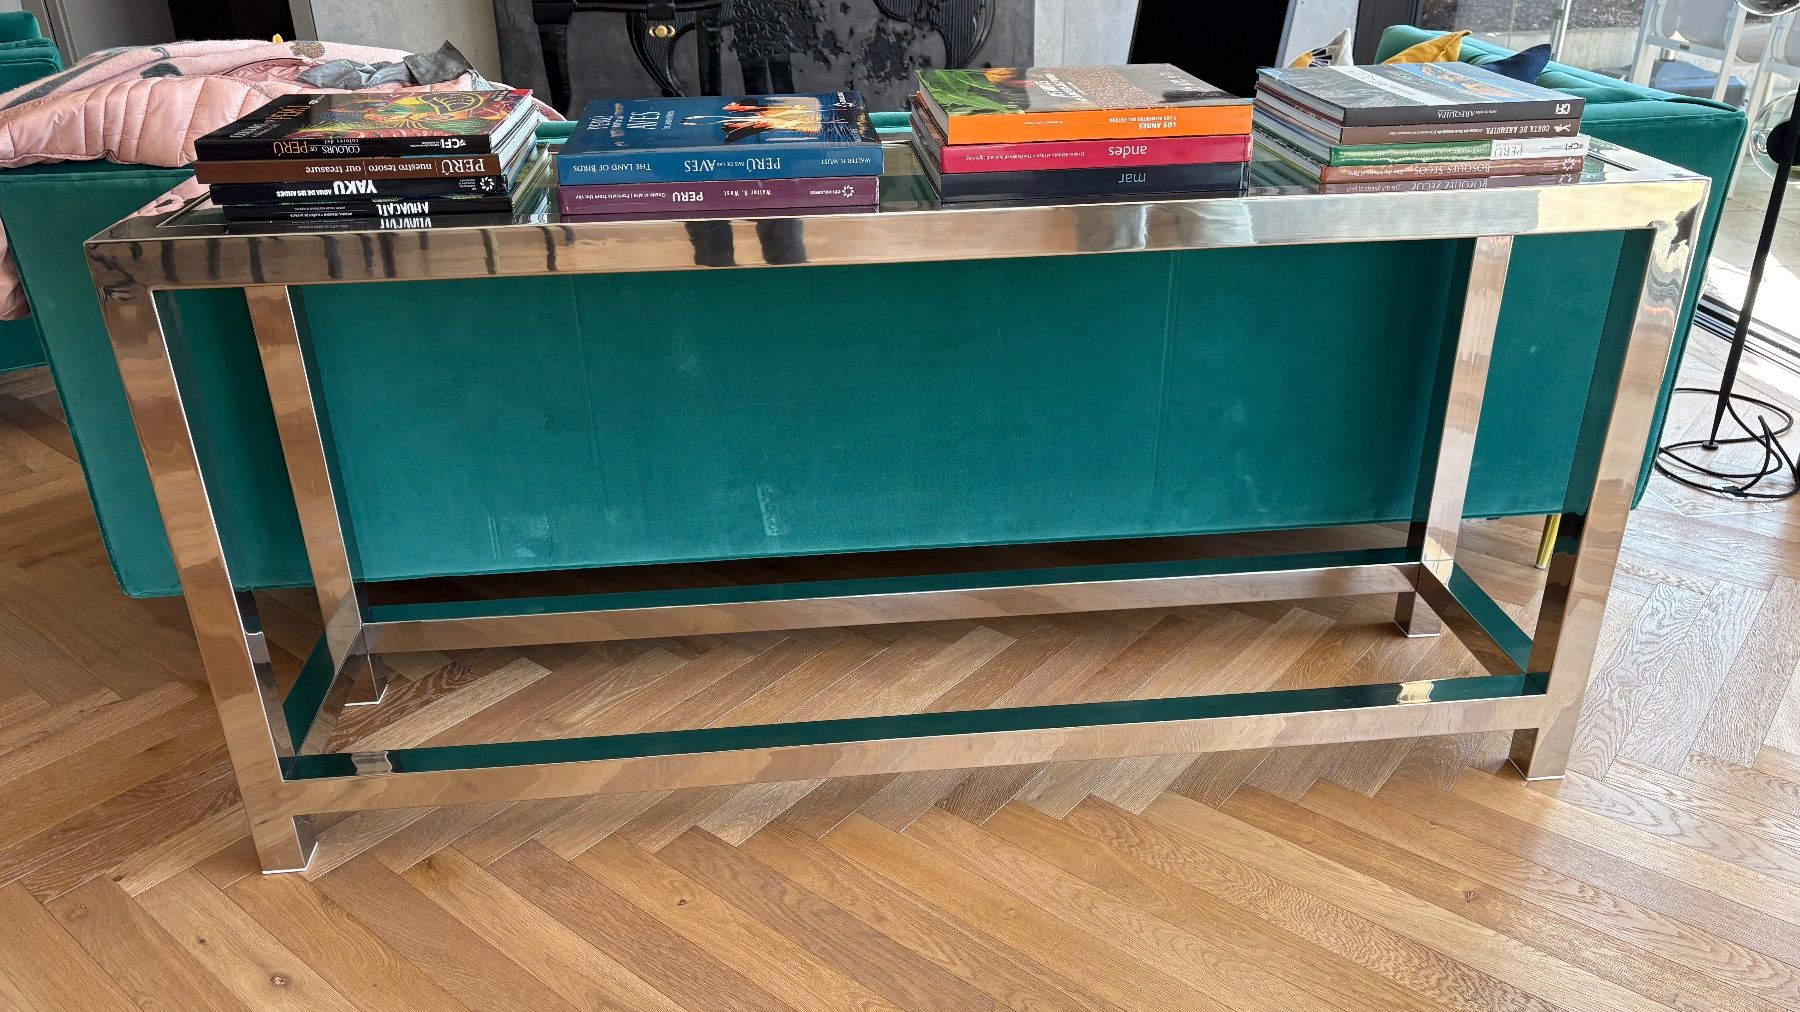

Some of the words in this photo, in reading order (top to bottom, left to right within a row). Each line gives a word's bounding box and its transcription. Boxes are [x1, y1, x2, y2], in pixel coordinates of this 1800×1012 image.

[1555, 103, 1571, 114] CFI
[1437, 109, 1476, 119] AREQUIPA
[626, 111, 660, 130] AVES
[1485, 126, 1518, 135] AREQUIPA
[1519, 125, 1529, 134] DE
[1529, 125, 1550, 133] COSTA
[440, 138, 461, 149] CFI
[1565, 142, 1580, 150] CFI
[272, 140, 309, 157] PERÚ
[321, 145, 361, 154] COLOURS
[1108, 145, 1148, 159] andes
[304, 165, 343, 174] treasure
[345, 165, 362, 173] our
[368, 164, 396, 173] tesoro
[398, 163, 432, 171] nuestro
[440, 158, 486, 176] PERÚ
[572, 164, 596, 172] BIRDS
[611, 163, 633, 171] LAND
[635, 163, 652, 171] THE
[683, 159, 716, 172] AVES
[746, 157, 781, 173] PERÚ
[1447, 163, 1490, 174] BOSQUES
[1413, 164, 1444, 176] SECOS
[1118, 172, 1147, 184] mar
[332, 179, 378, 196] YAKU
[275, 190, 297, 198] ANDES
[671, 191, 704, 202] PERU
[750, 189, 772, 197] Walter
